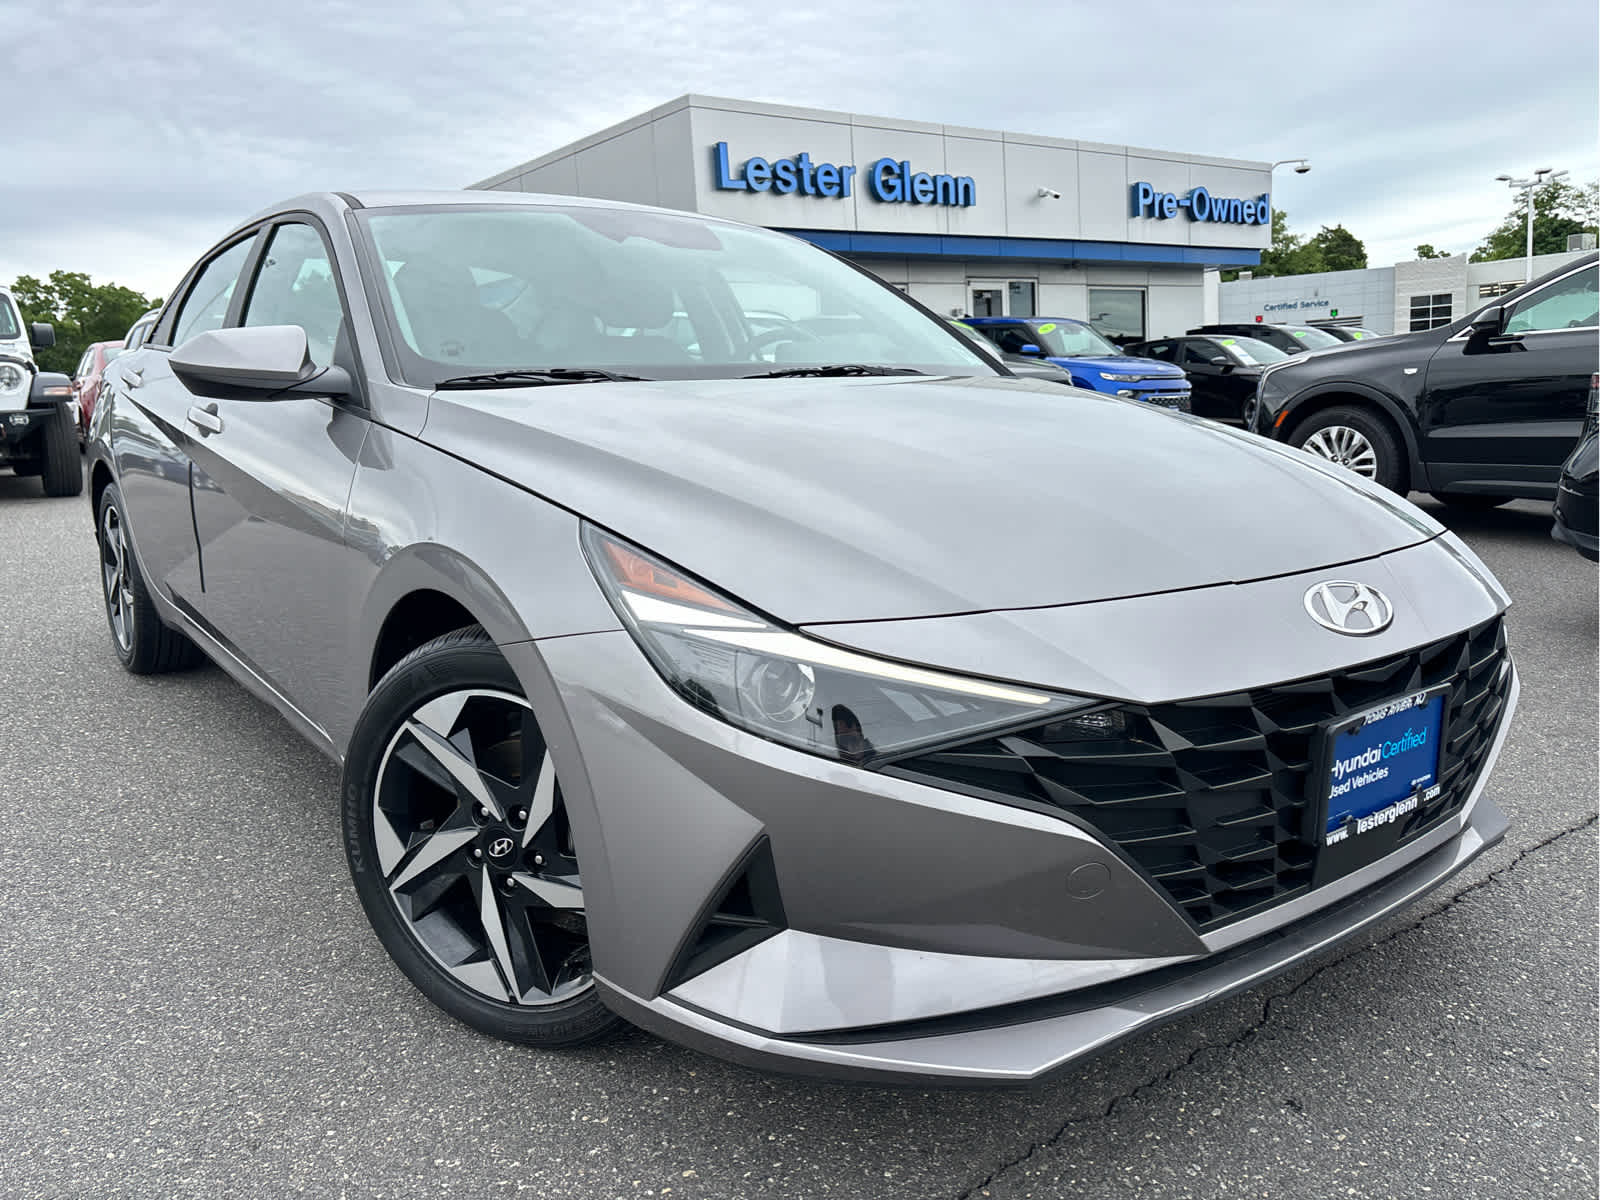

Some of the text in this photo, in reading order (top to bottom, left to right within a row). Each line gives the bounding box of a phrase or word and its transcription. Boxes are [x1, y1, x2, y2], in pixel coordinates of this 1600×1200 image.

[711, 141, 977, 206] Lester Glenn
[1132, 181, 1270, 225] Pre-Owned
[1263, 300, 1329, 311] Certified Service
[1382, 727, 1427, 759] Certified
[1352, 767, 1389, 789] Vehicles
[346, 783, 365, 873] KUMHO
